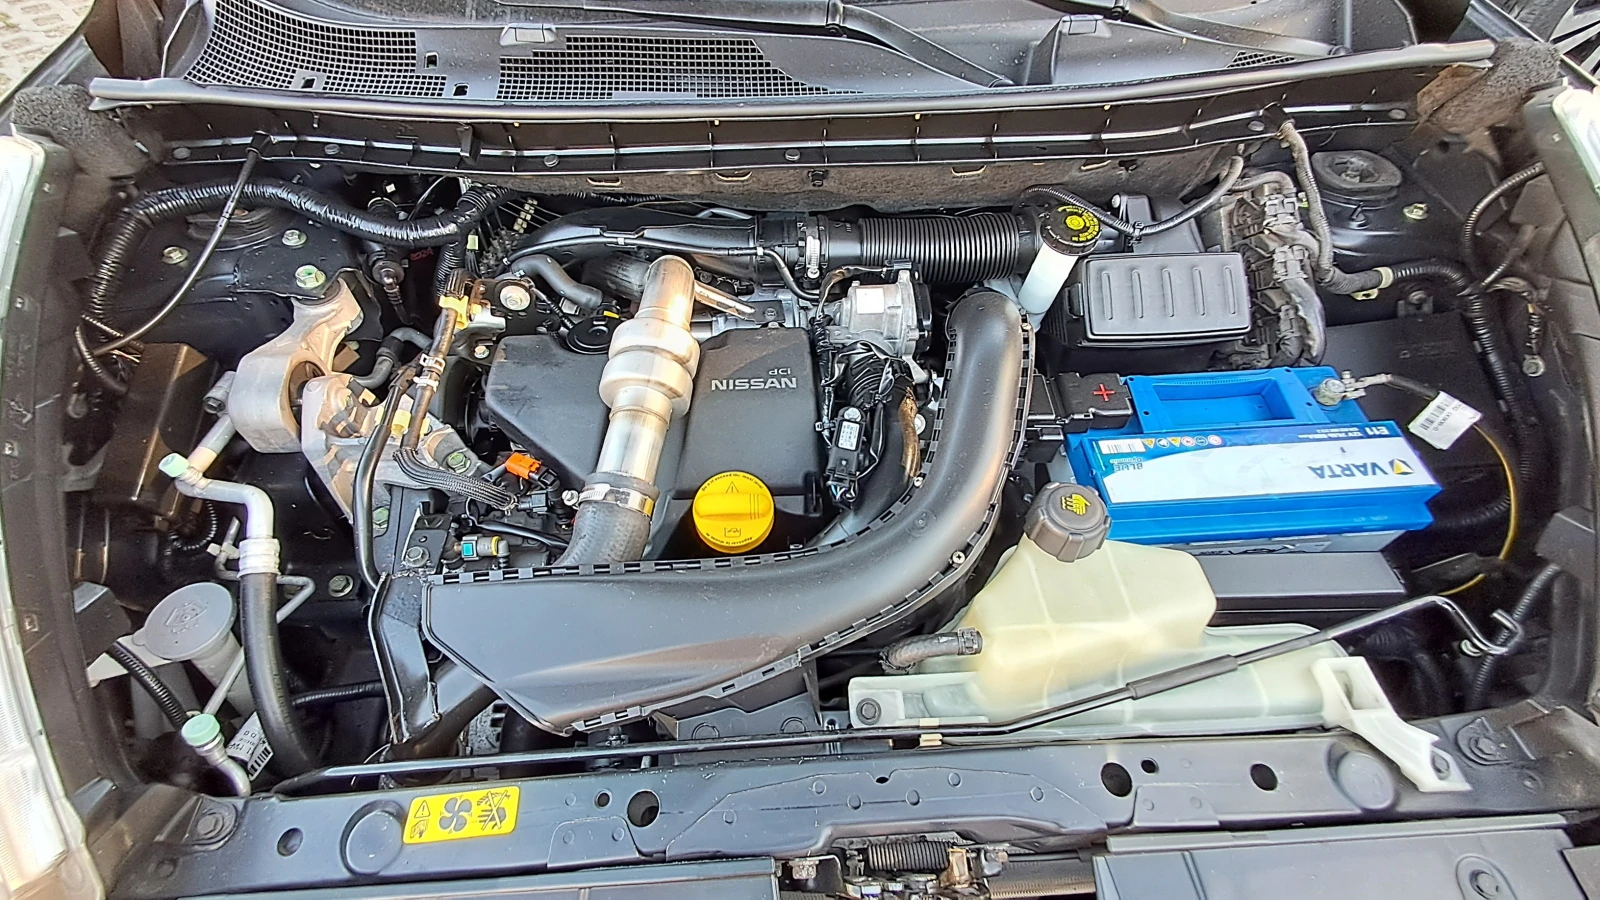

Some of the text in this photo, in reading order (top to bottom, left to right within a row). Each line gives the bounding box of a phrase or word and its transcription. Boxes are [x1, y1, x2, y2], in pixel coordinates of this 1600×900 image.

[711, 377, 796, 391] NISSAN
[1364, 425, 1389, 436] E11
[1114, 462, 1143, 473] BLUE
[1307, 461, 1388, 480] VARTA
